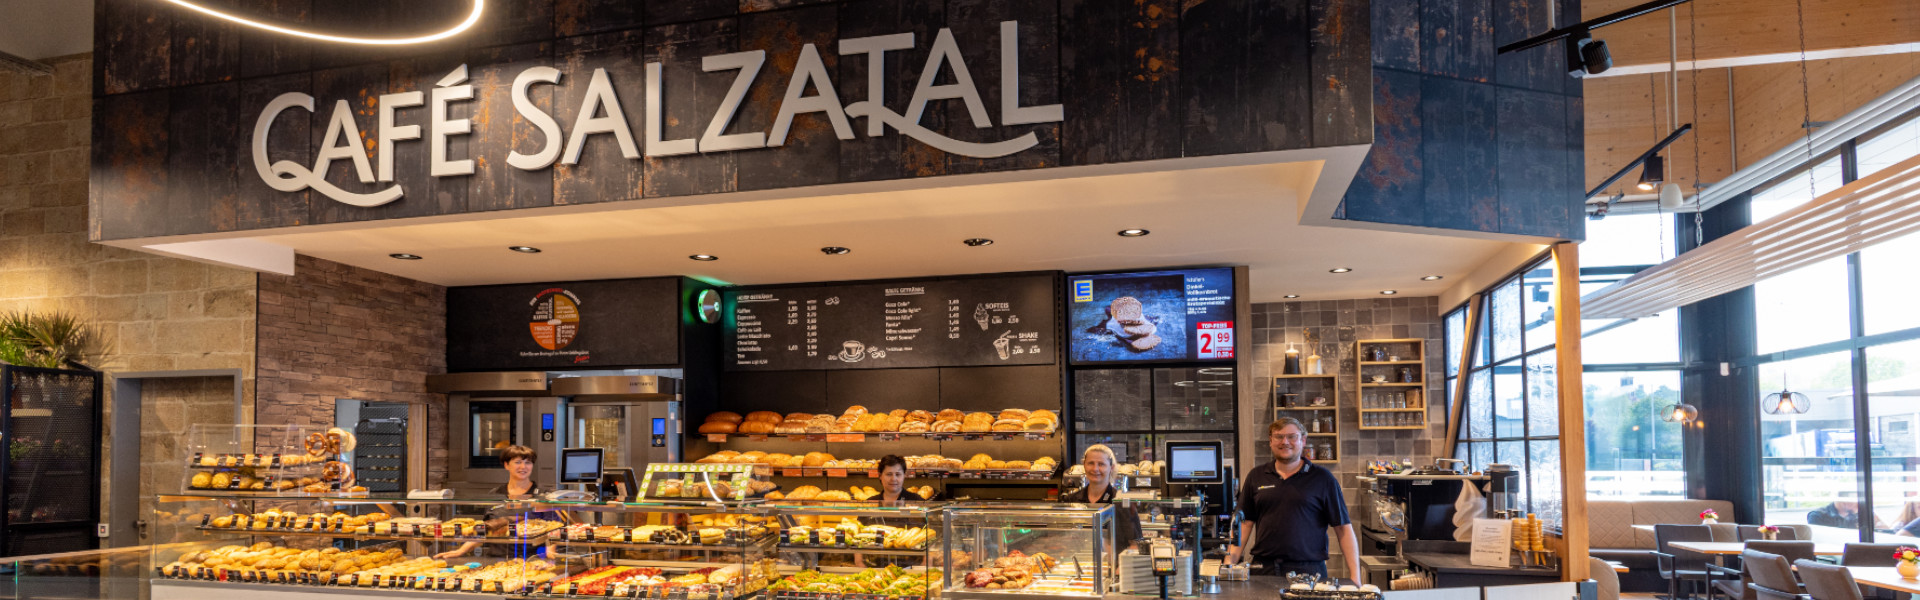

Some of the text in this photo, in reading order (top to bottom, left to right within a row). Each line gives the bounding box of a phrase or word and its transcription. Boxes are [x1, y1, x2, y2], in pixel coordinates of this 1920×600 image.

[252, 19, 1065, 207] CAFÉ SALZATAL
[984, 302, 1009, 310] SOFTEIS
[1200, 332, 1230, 354] 2 99
